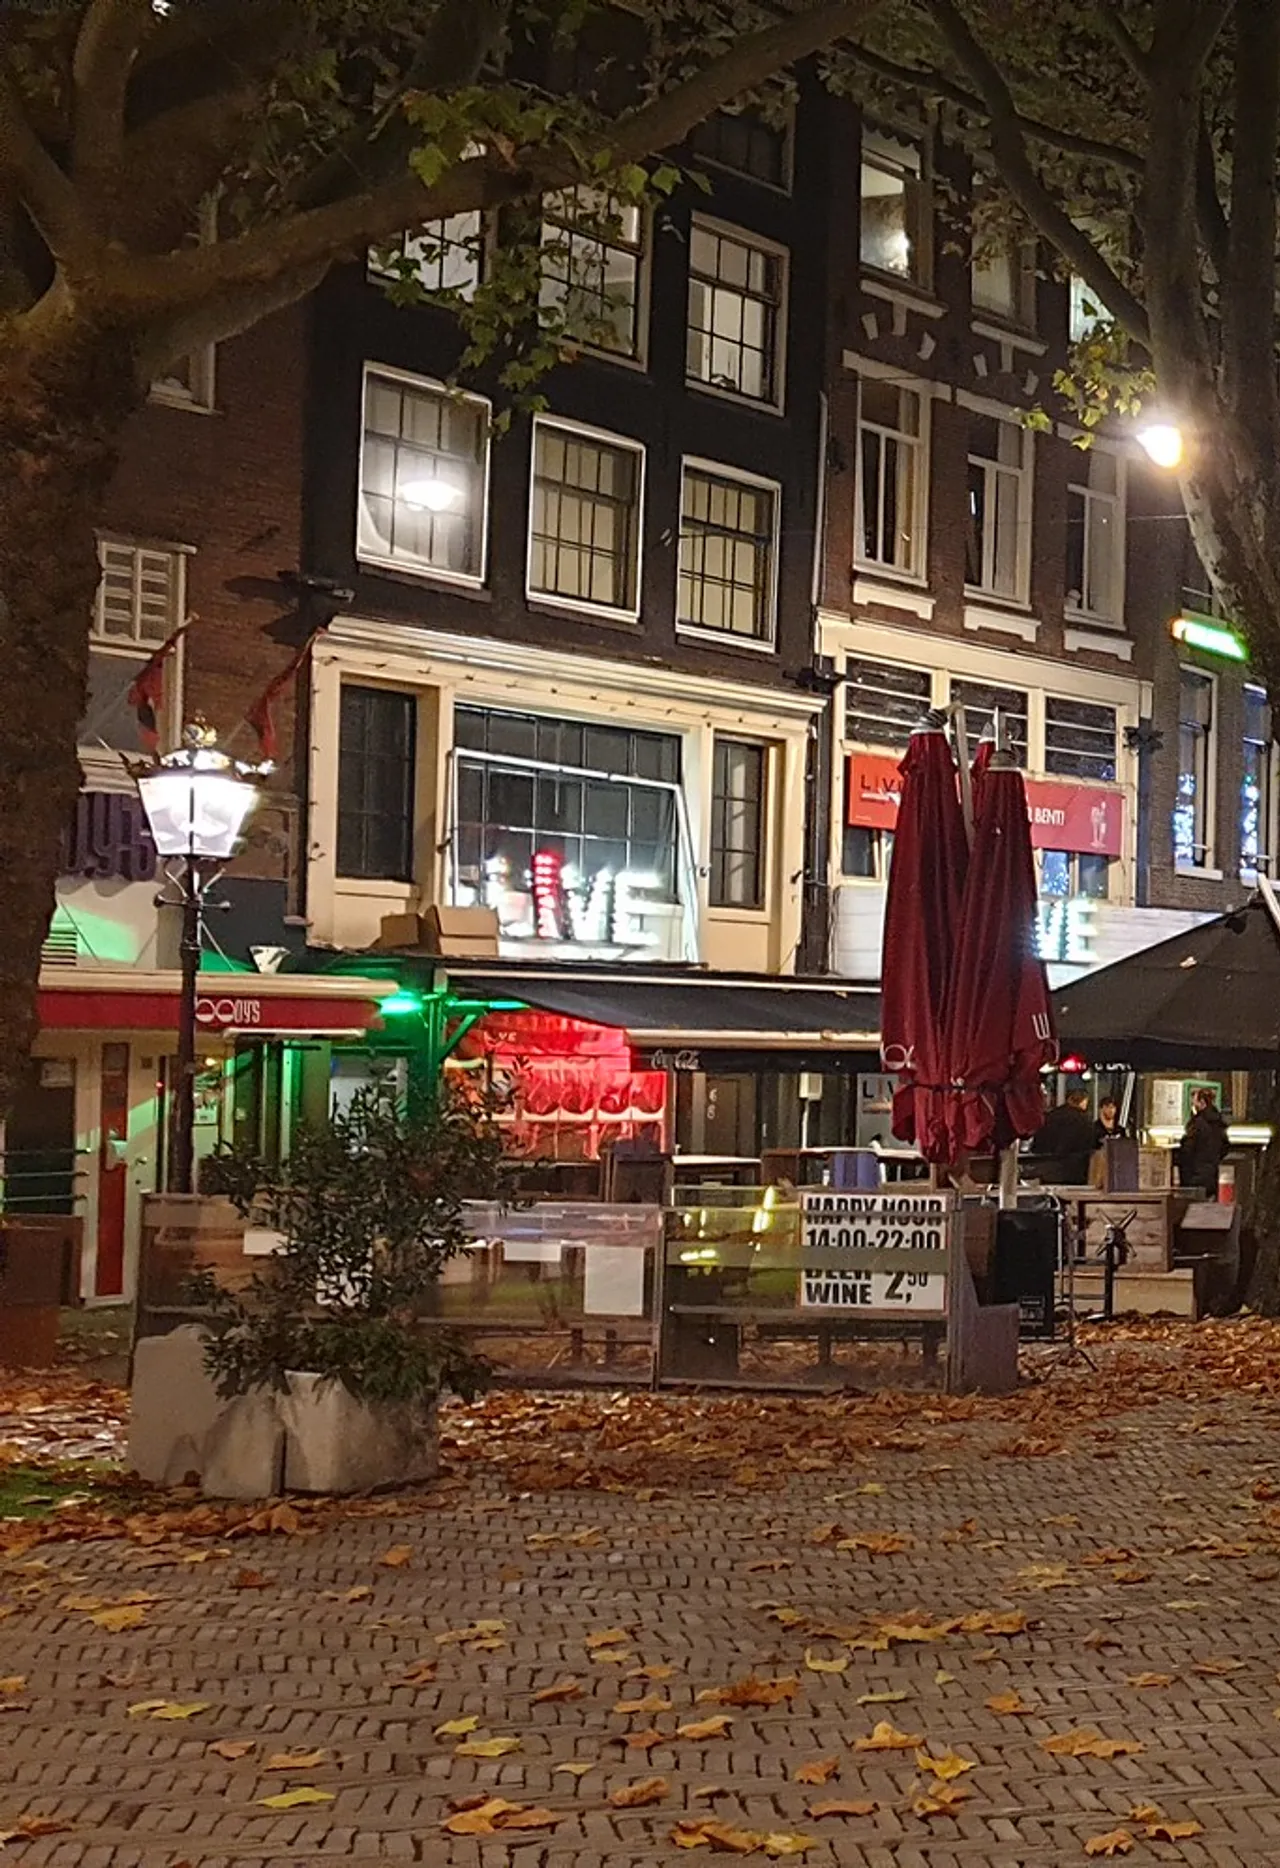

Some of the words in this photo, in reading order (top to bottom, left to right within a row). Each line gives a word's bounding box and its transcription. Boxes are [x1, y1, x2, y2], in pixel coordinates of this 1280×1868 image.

[858, 774, 899, 793] LIV
[806, 1197, 877, 1226] HAPPY
[881, 1198, 943, 1227] HOUR
[806, 1282, 872, 1305] WINE
